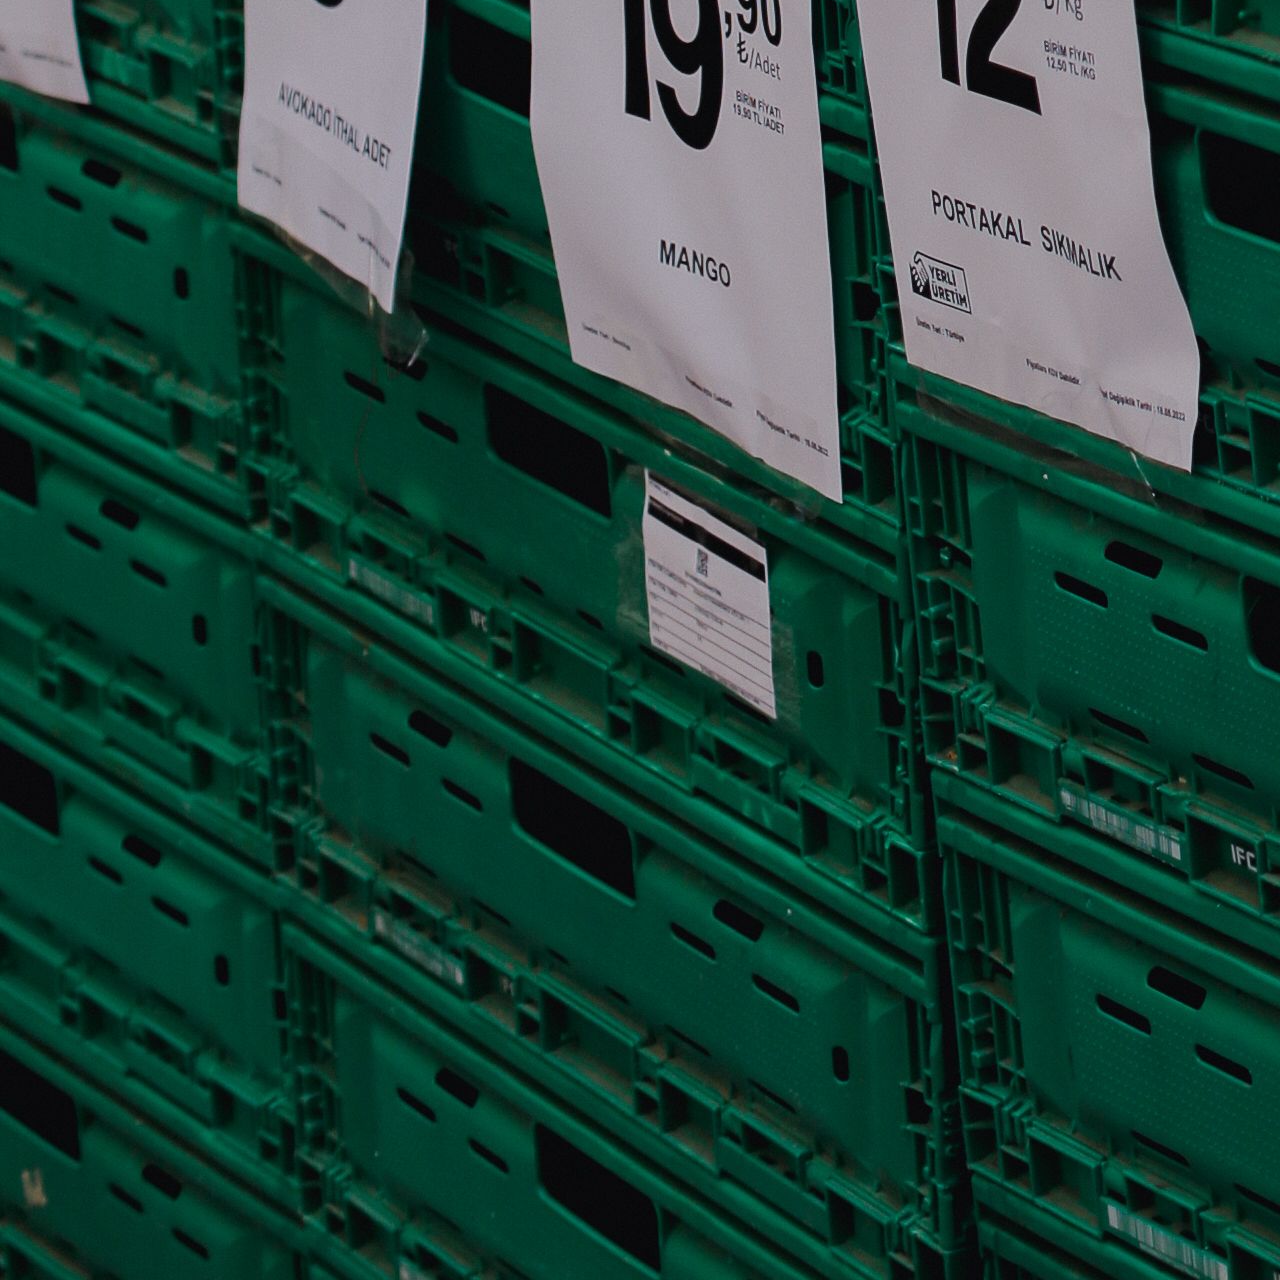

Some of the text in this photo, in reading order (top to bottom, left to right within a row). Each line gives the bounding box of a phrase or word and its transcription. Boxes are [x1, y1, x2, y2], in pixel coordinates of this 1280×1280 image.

[278, 81, 331, 132] AVOKADO
[362, 134, 392, 170] ADET
[931, 189, 1123, 282] PORTAKAL SIKMALIK
[659, 239, 731, 288] MANGO
[928, 264, 957, 287] YERLİ
[931, 281, 968, 308] ÜRETİM
